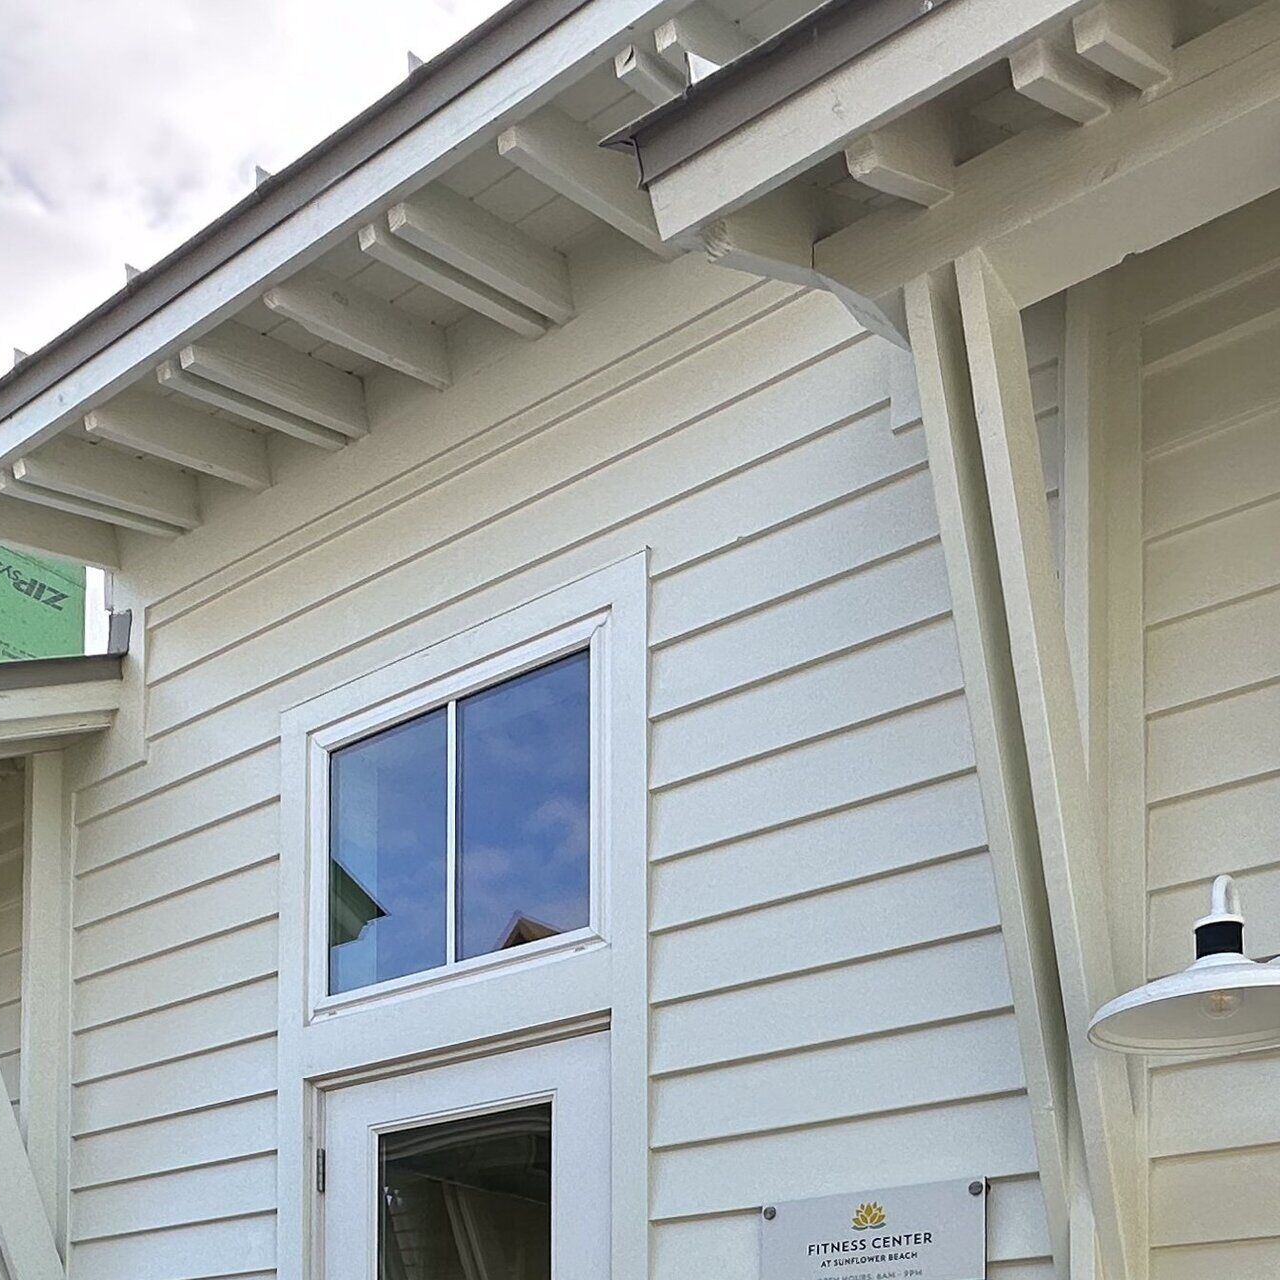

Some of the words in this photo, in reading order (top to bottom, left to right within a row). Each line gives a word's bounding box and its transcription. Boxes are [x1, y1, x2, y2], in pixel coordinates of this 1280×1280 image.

[807, 1239, 867, 1256] FITNESS
[871, 1232, 933, 1249] CENTER
[820, 1259, 831, 1268] AT
[833, 1254, 887, 1267] SUNFLOWER
[888, 1251, 918, 1261] BEACH
